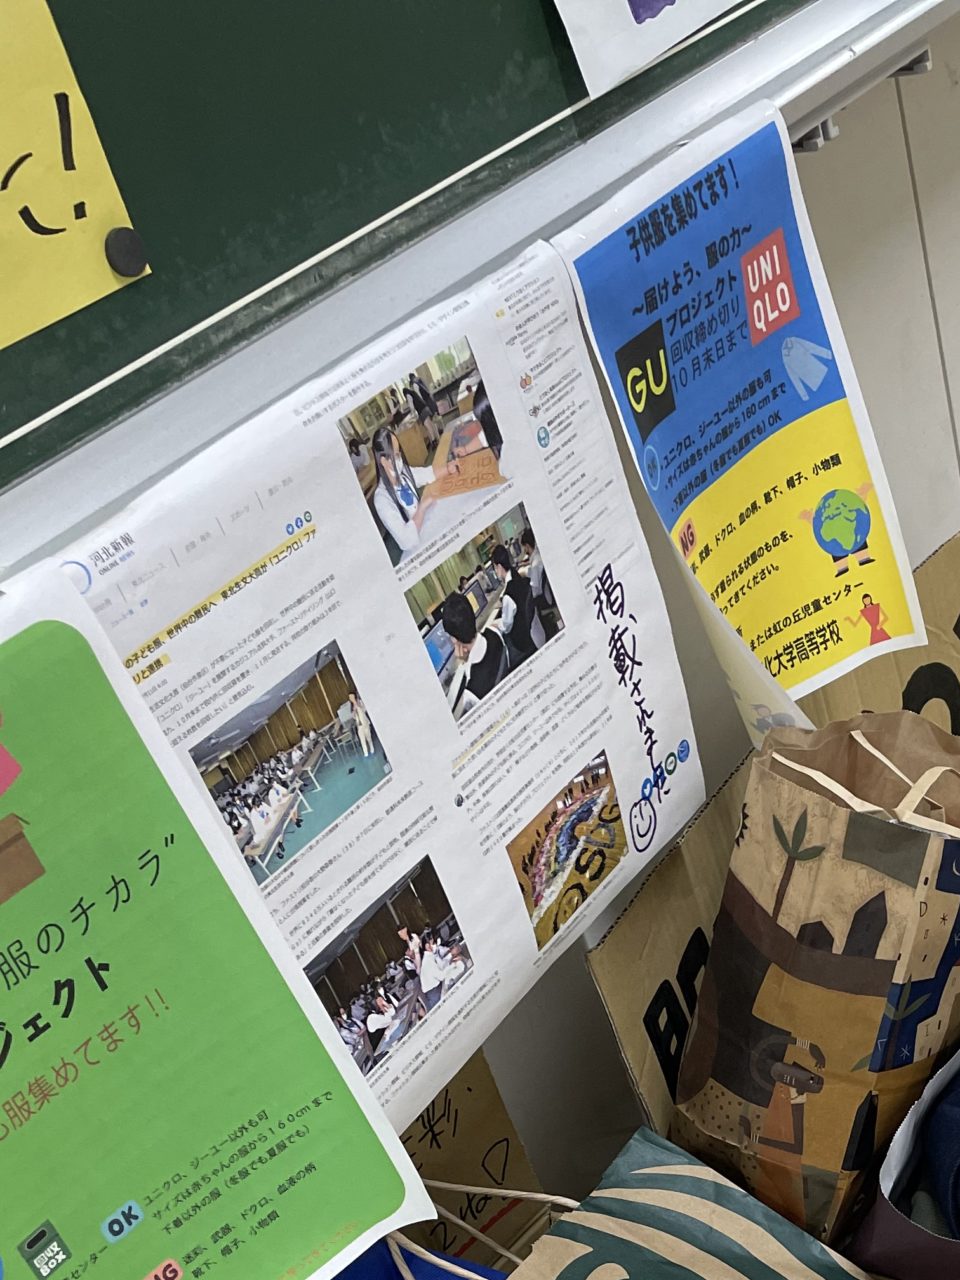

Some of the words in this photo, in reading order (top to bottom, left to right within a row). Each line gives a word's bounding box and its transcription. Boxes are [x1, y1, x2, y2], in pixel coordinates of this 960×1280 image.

[624, 156, 740, 263] 子供服を集めてます！
[746, 244, 782, 293] UNI
[664, 268, 738, 336] プロジェクト
[749, 280, 794, 331] QLO
[668, 295, 741, 365] 回収締め切り
[626, 348, 672, 413] GU
[88, 530, 135, 567] 河北新報
[677, 523, 695, 557] NG
[718, 559, 779, 614] ってきてください。
[106, 1205, 139, 1237] OK
[32, 1242, 62, 1267] 回収
[38, 1250, 67, 1276] BOX
